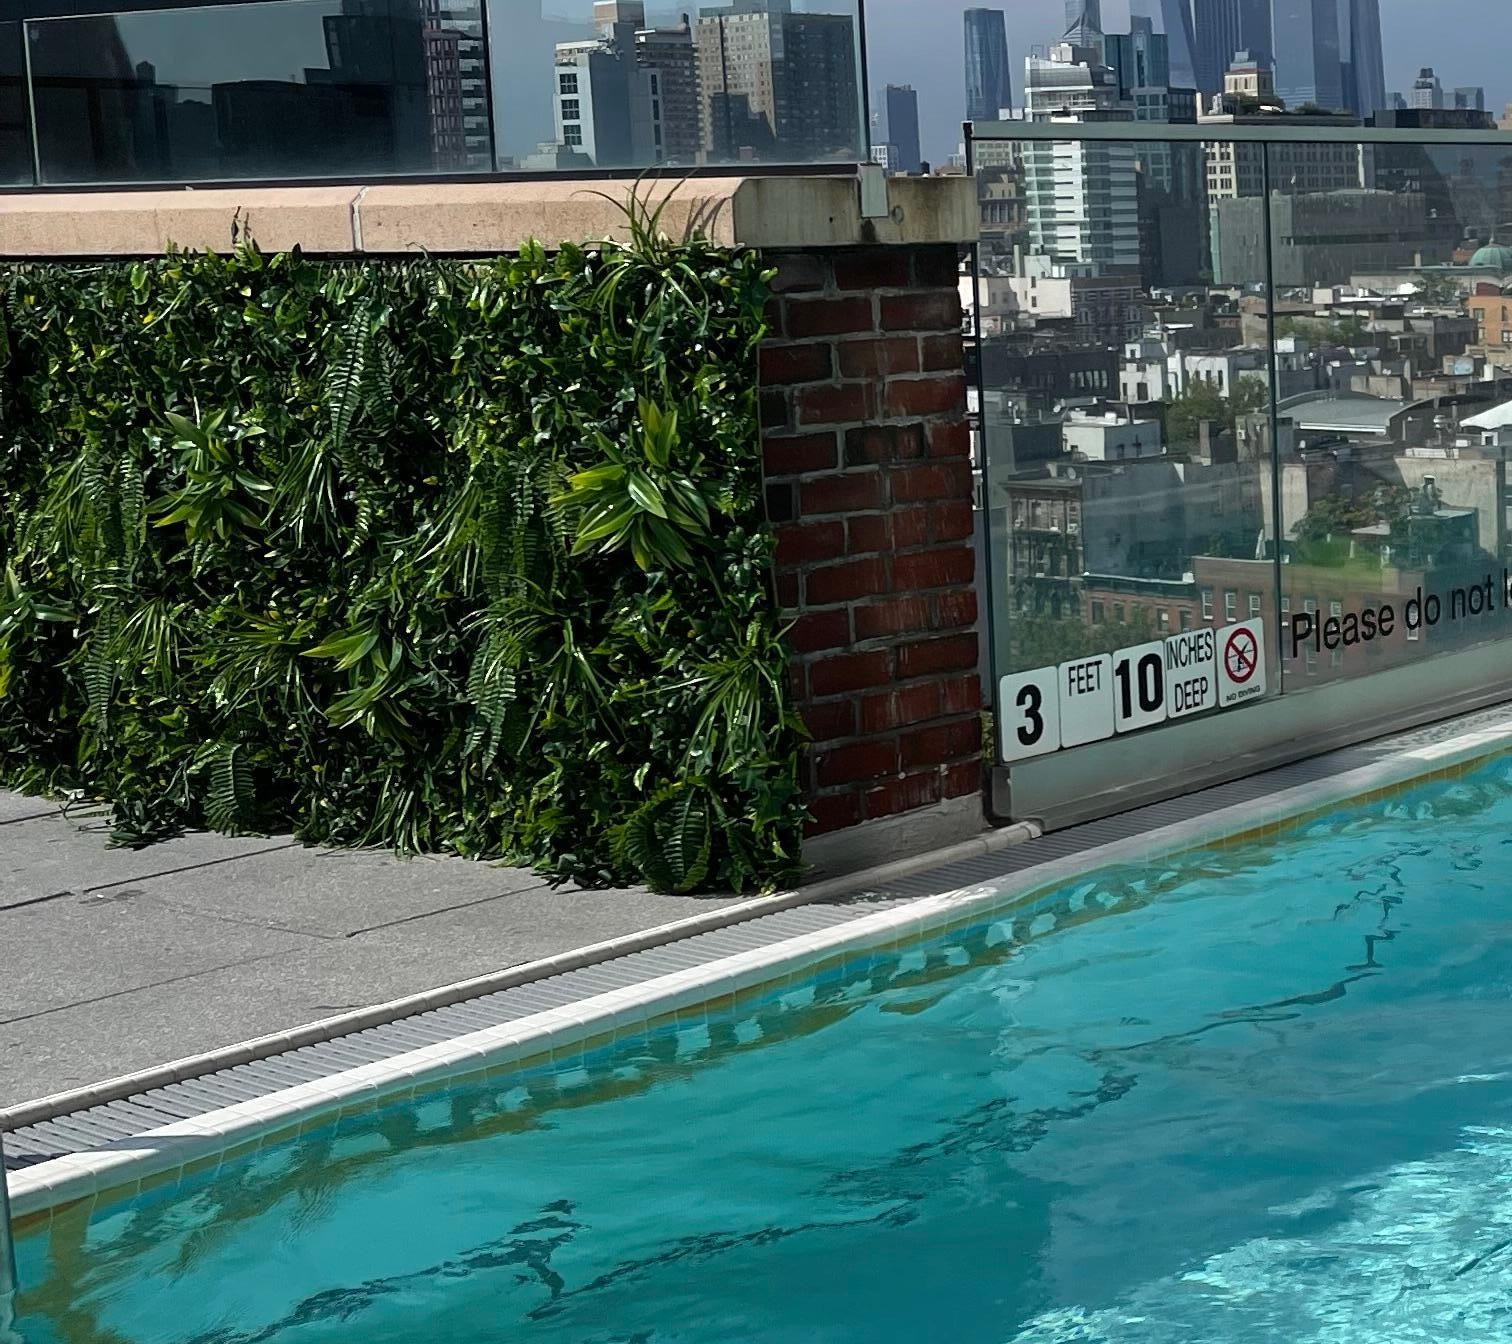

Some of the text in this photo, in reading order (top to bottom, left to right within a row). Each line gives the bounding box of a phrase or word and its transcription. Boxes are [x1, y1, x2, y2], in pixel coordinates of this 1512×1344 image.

[1292, 605, 1394, 658] Please
[1405, 586, 1441, 630] do
[1450, 574, 1494, 620] not
[1016, 632, 1212, 745] 3 FEET 10 INCHES
[1175, 677, 1208, 712] DEEP
[1226, 693, 1237, 702] NO
